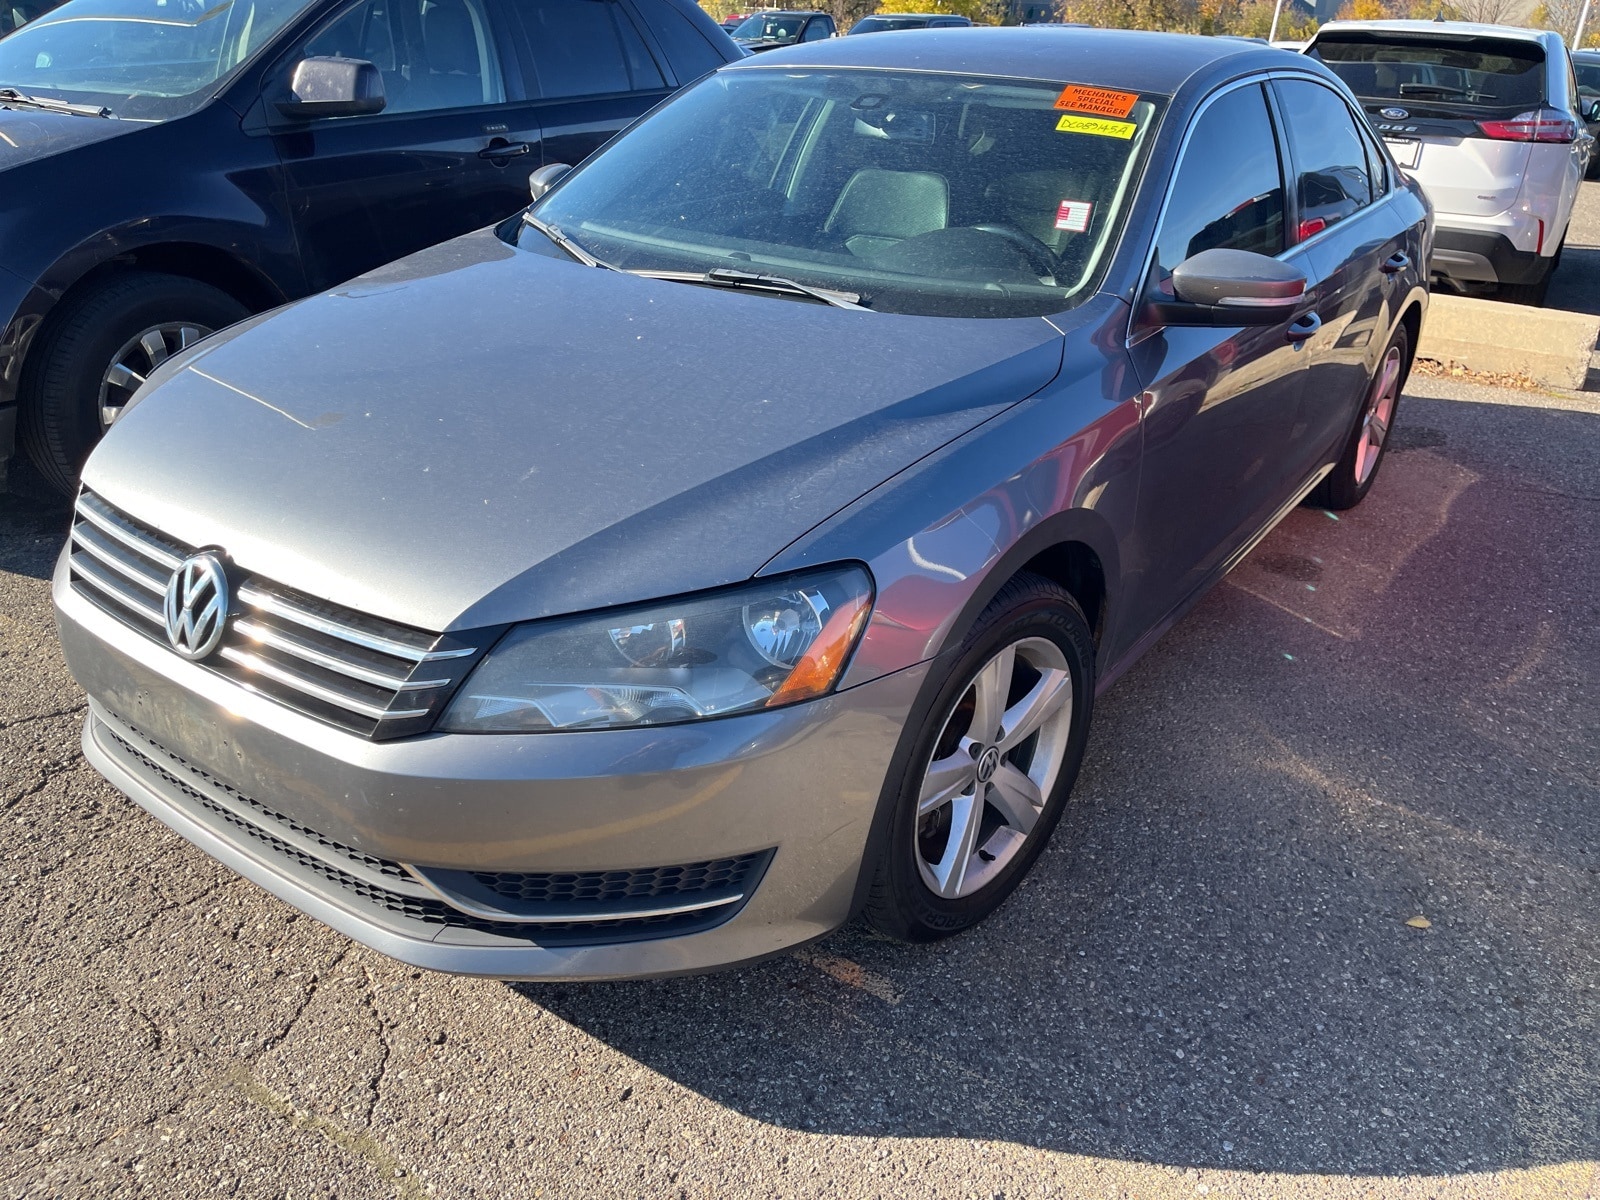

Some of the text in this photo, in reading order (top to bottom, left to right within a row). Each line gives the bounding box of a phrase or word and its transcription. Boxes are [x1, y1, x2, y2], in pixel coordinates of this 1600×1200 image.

[1073, 88, 1128, 102] MECHANICS
[1077, 95, 1115, 106] SPECIAL
[1058, 100, 1126, 115] SEE MANAGER
[1375, 123, 1418, 132] DGE
[1048, 611, 1090, 669] TOURING
